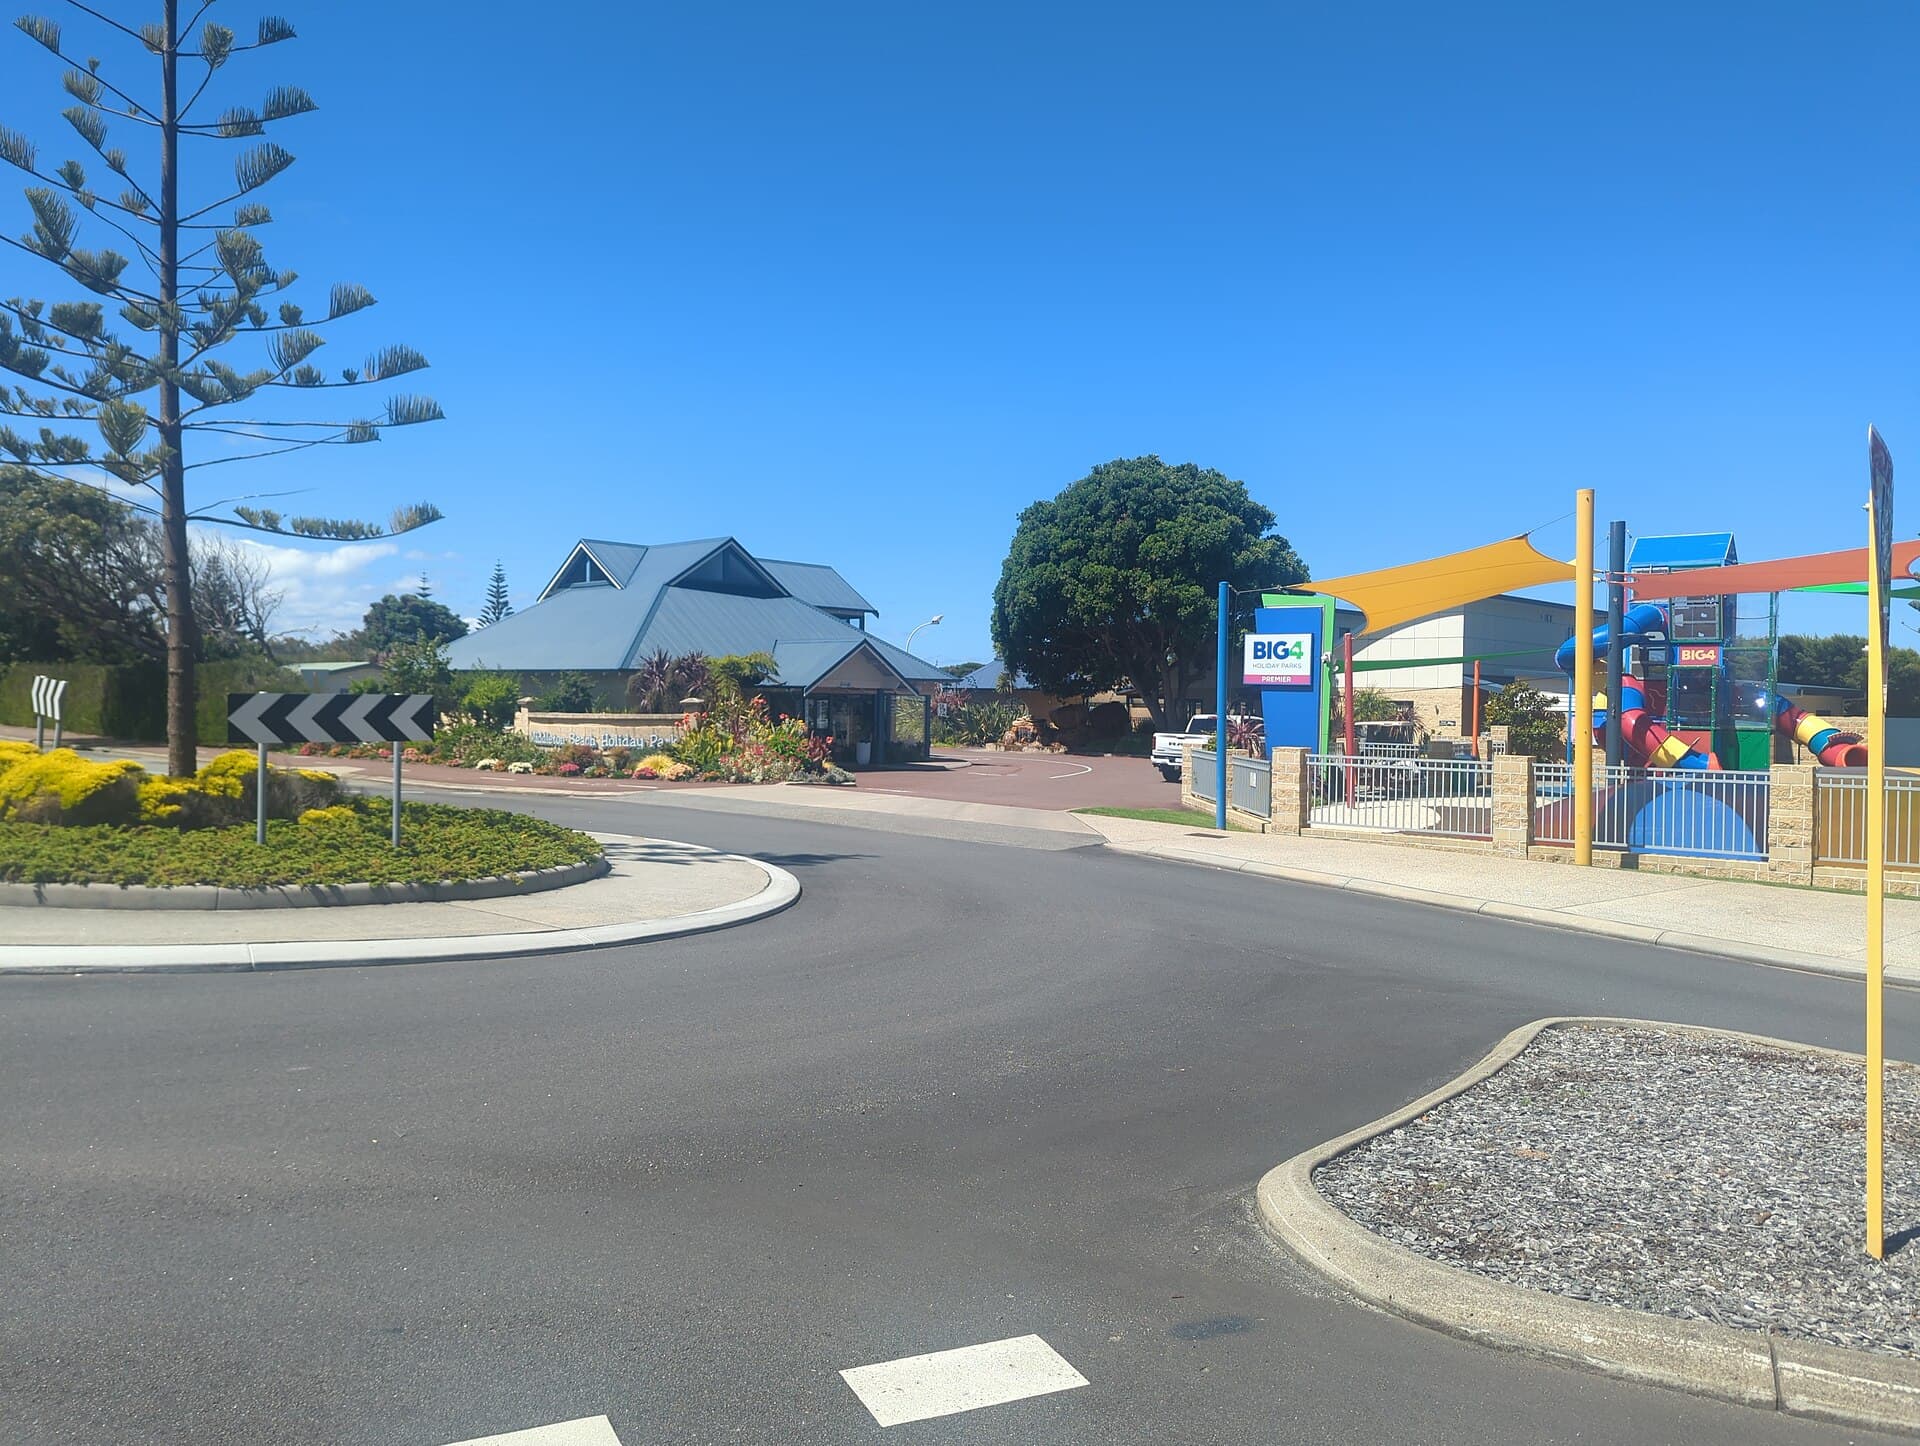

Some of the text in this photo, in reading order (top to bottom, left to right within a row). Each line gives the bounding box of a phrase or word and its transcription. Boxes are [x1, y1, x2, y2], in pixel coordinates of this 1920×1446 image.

[1253, 641, 1304, 659] BIG4
[1681, 649, 1716, 661] BIG4
[1261, 675, 1292, 683] PREMIER
[569, 732, 596, 748] Beach
[601, 733, 644, 749] Holiday
